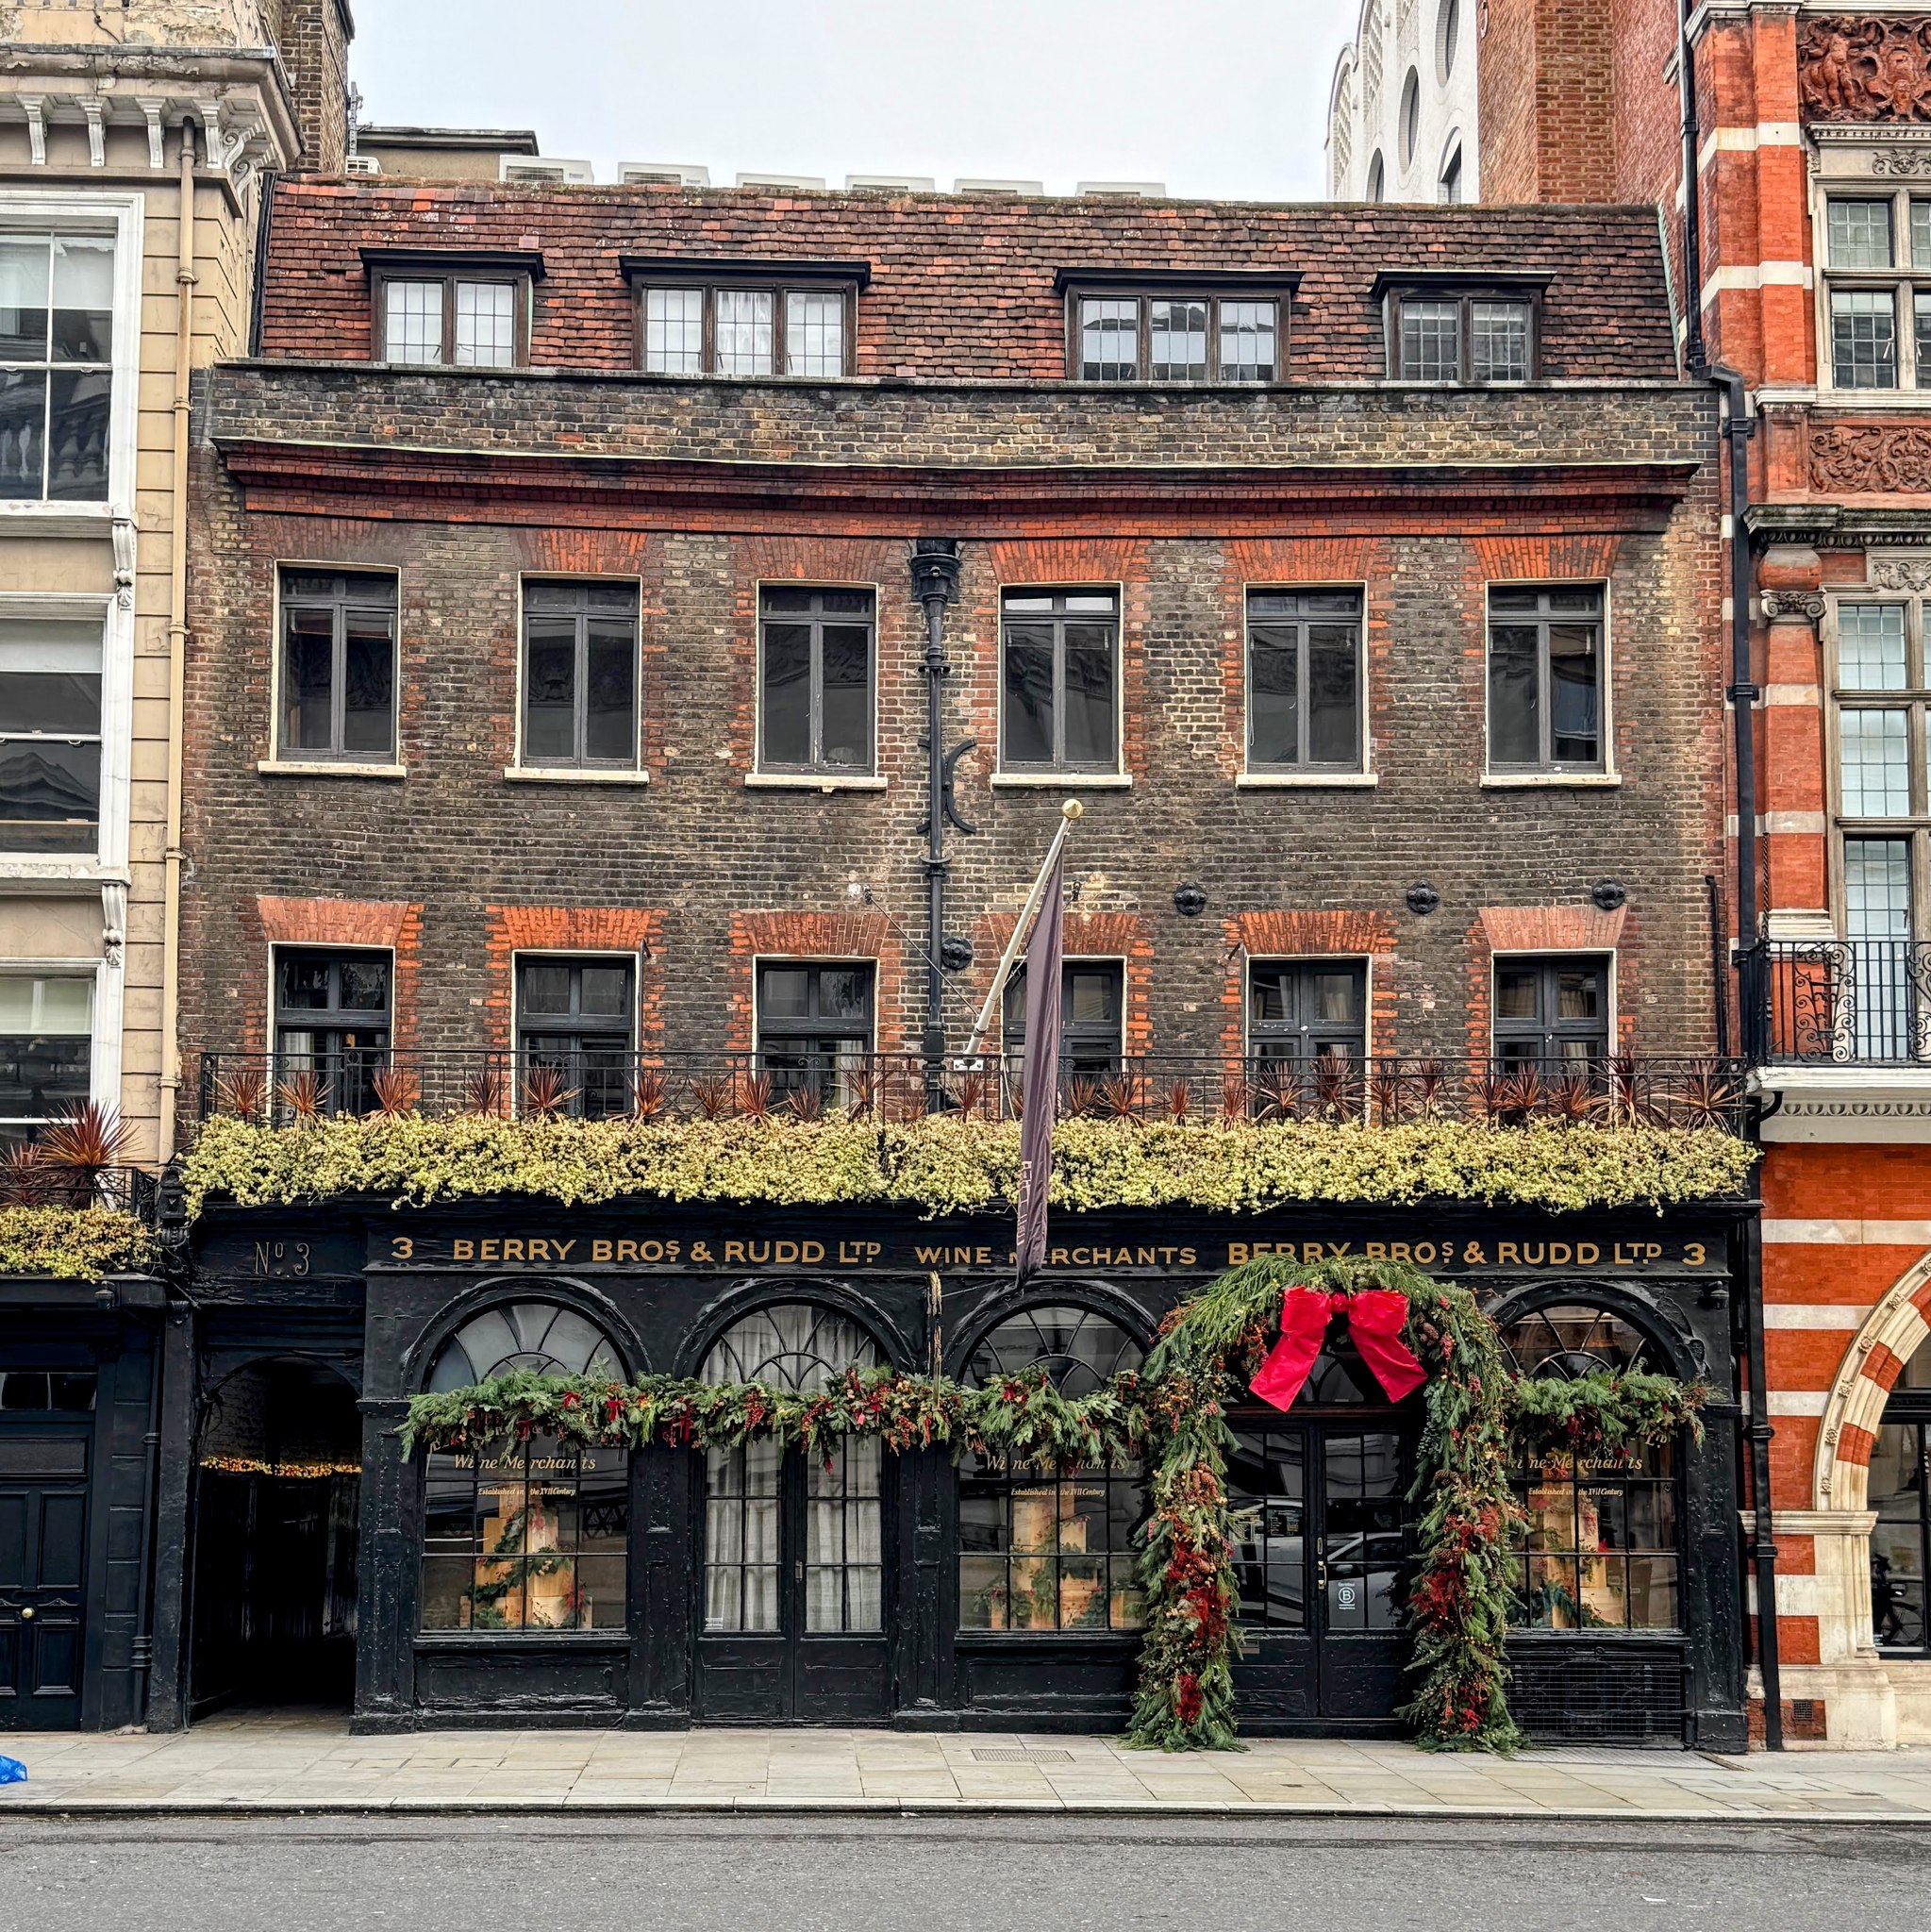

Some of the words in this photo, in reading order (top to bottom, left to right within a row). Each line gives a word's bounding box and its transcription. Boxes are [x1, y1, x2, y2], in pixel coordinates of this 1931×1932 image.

[391, 1237, 413, 1259] 3
[453, 1239, 576, 1260] BERRY
[690, 1241, 714, 1262] &
[724, 1241, 825, 1263] RUDD
[914, 1246, 991, 1265] WINE
[1008, 1247, 1197, 1265] RCHANTS
[1463, 1241, 1487, 1264] &
[1498, 1242, 1600, 1265] RUDD
[1682, 1243, 1706, 1266] 3
[293, 1241, 310, 1276] 3
[455, 1454, 499, 1470] Wine
[504, 1455, 596, 1470] Merchants
[987, 1455, 1031, 1470] Wine
[478, 1487, 515, 1496] Established
[530, 1487, 540, 1496] the
[553, 1487, 576, 1497] Century
[1011, 1488, 1047, 1496] Established
[1060, 1488, 1069, 1496] the
[1082, 1488, 1105, 1497] Century
[1528, 1487, 1565, 1495] Established
[1578, 1487, 1588, 1495] the
[1601, 1487, 1623, 1497] Century
[1341, 1590, 1352, 1601] B
